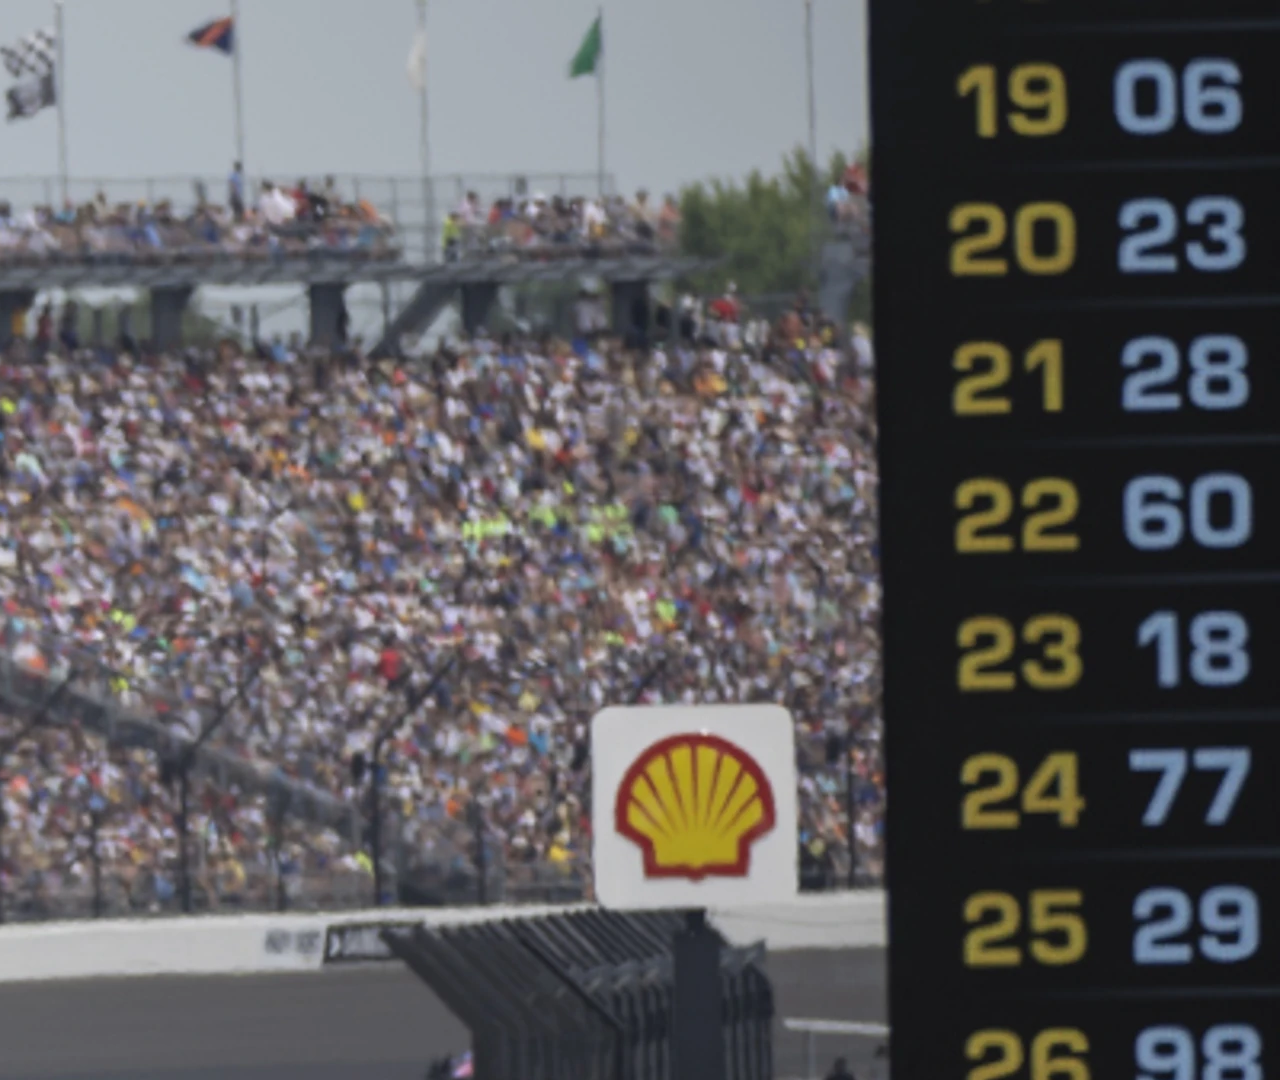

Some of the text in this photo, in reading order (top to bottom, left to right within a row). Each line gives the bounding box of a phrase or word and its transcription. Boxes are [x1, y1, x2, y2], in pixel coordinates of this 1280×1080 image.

[960, 60, 1241, 136] 19 06
[952, 197, 1244, 273] 20 23
[955, 336, 1248, 413] 21 28
[957, 474, 1251, 551] 22 60
[960, 612, 1248, 688] 23 18
[963, 748, 1249, 827] 24 77
[966, 887, 1258, 964] 25 29
